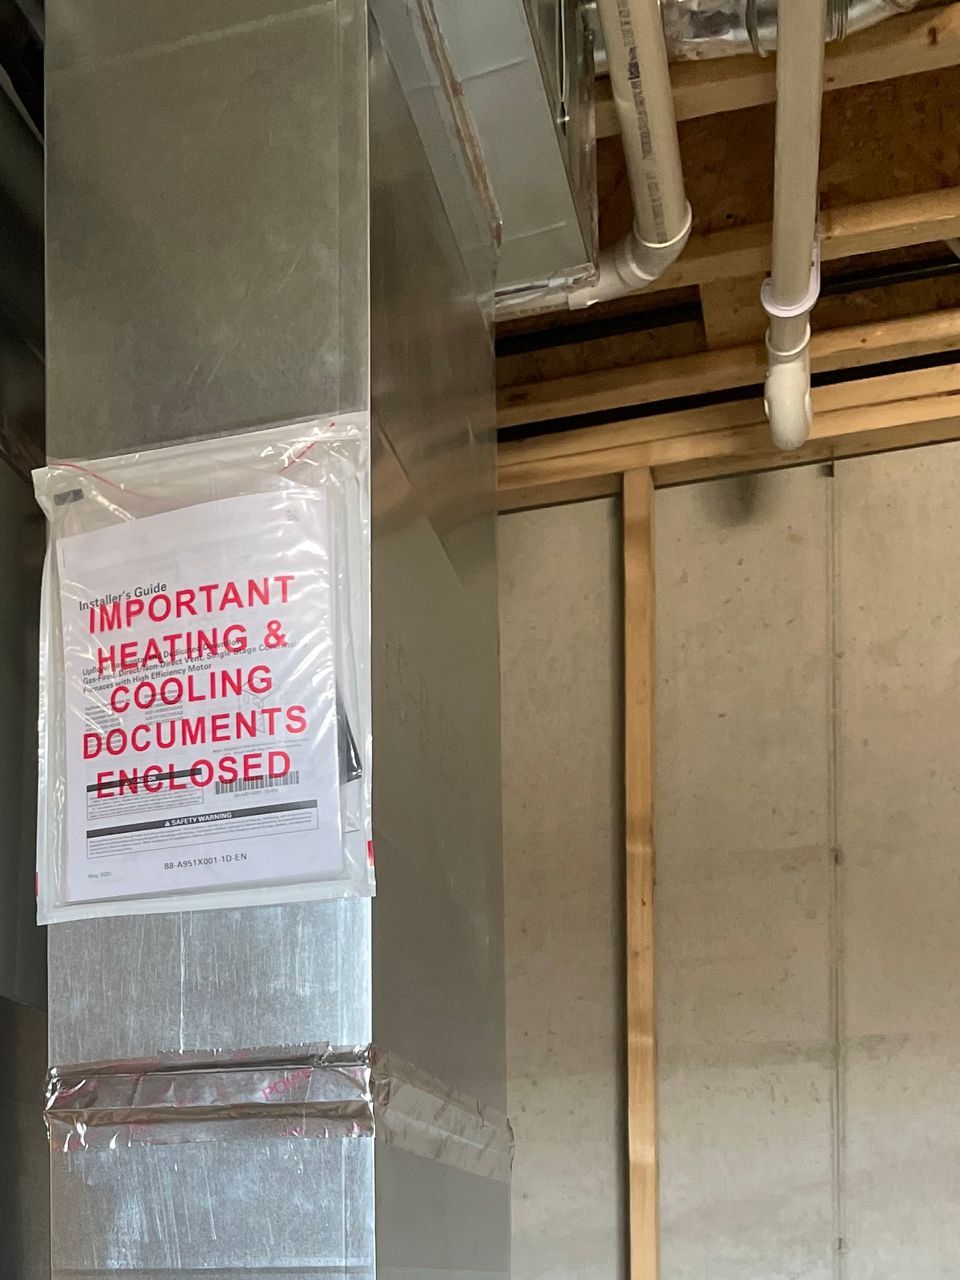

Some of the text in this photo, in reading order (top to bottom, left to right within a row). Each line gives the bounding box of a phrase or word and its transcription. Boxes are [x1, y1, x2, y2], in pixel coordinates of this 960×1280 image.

[79, 582, 167, 611] Installer's Guide
[90, 575, 295, 634] IMPORTANT
[97, 620, 286, 675] HEATING &
[111, 665, 273, 713] COOLING
[115, 678, 132, 687] with
[133, 673, 150, 685] High
[151, 668, 186, 680] Efficiency
[188, 663, 212, 673] Motor
[83, 705, 307, 760] DOCUMENTS
[97, 751, 291, 798] ENCLOSED
[171, 812, 232, 826] SAFETY WARNING
[164, 852, 247, 870] 88-A951X001-1D-EN
